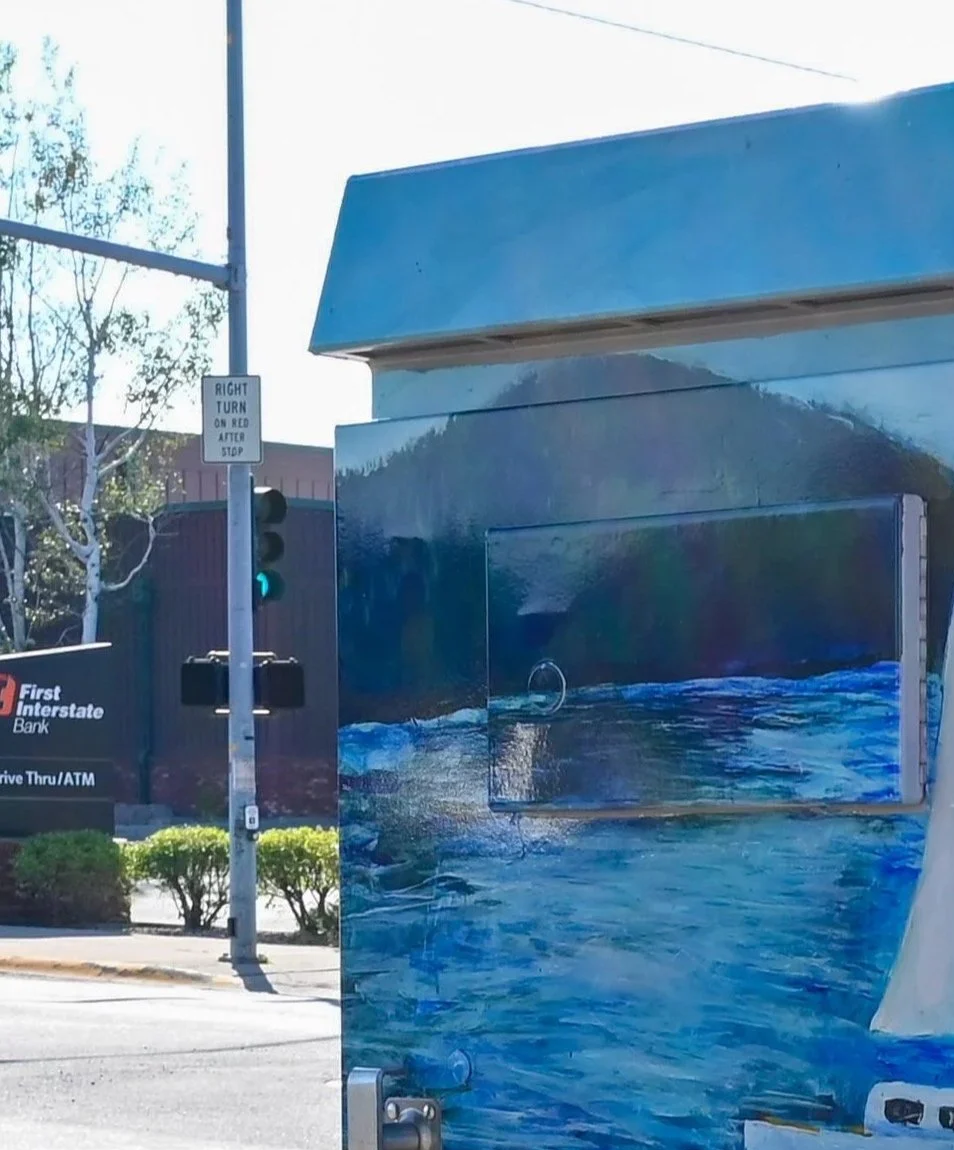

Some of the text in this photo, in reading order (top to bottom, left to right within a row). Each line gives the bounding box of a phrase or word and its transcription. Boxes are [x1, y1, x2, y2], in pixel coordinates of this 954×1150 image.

[215, 382, 248, 396] RIGHT
[217, 401, 247, 414] TURN
[214, 418, 249, 428] ON RED
[219, 432, 245, 442] AFTER
[222, 447, 243, 457] STOP
[19, 684, 61, 701] First
[16, 701, 104, 719] Interstate
[13, 718, 49, 734] Bank
[0, 770, 23, 785] rive
